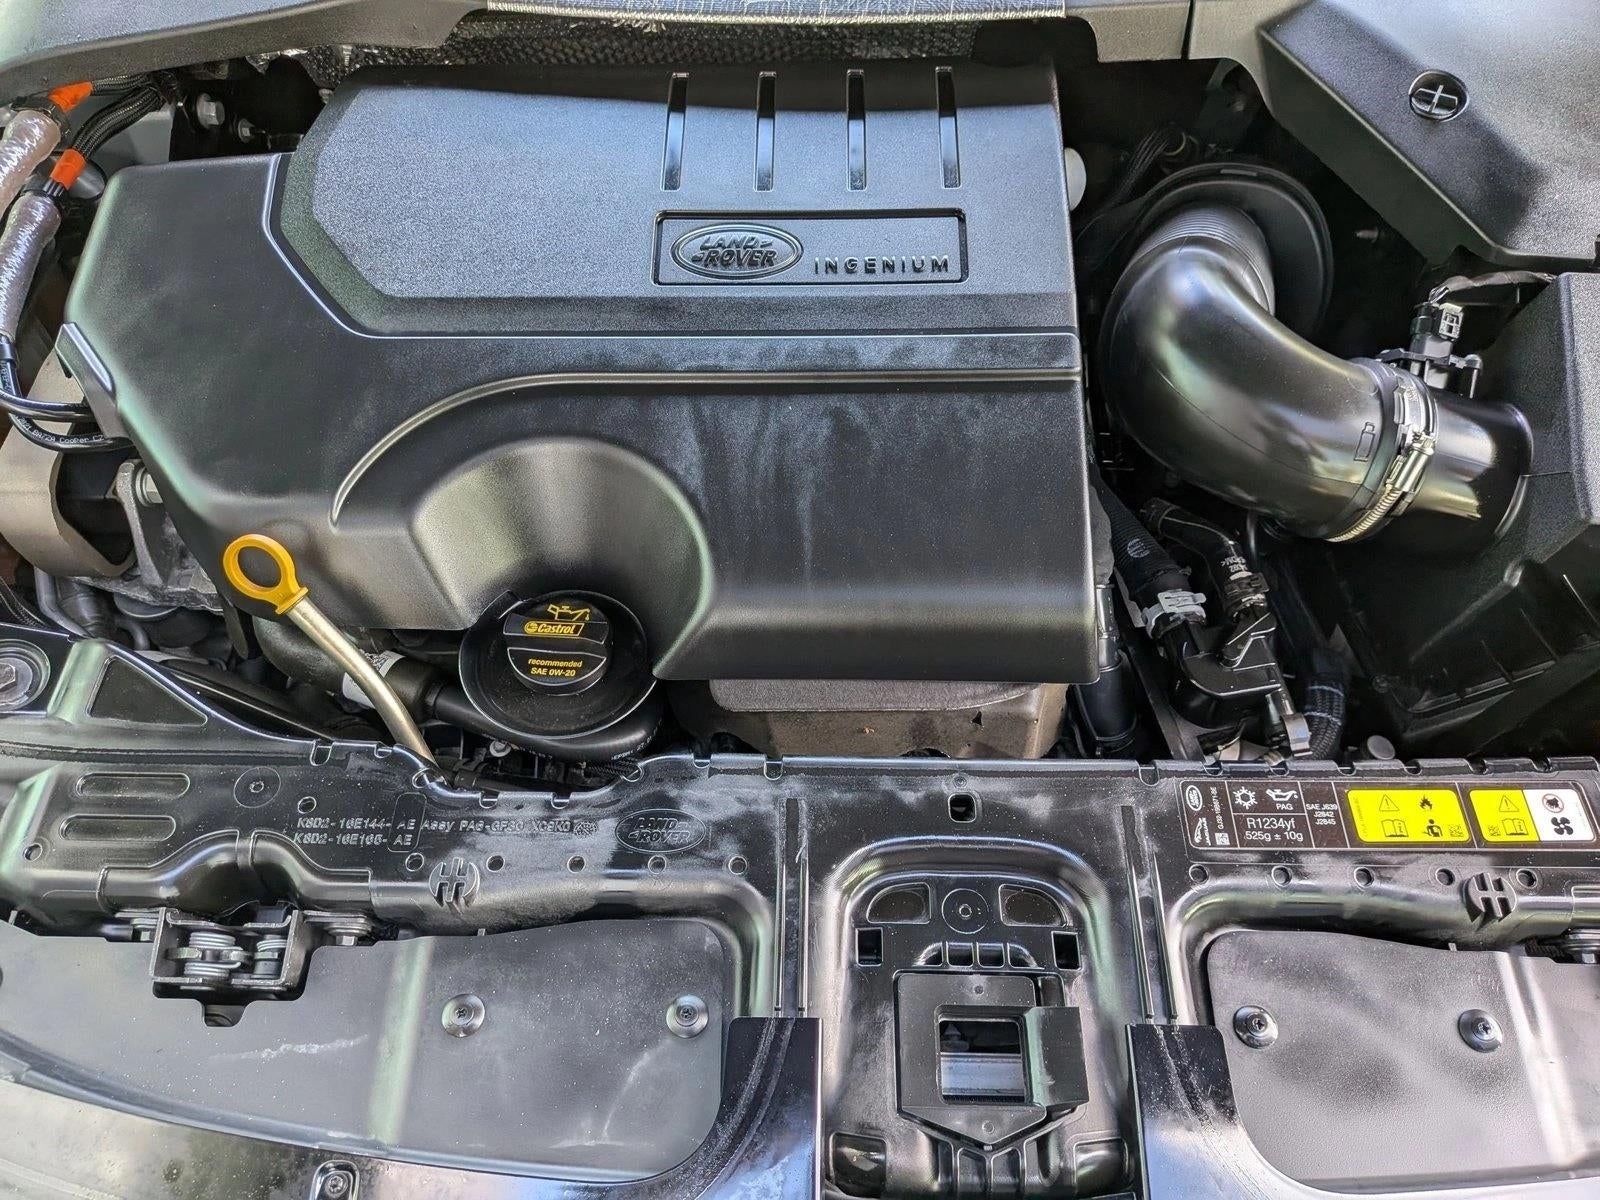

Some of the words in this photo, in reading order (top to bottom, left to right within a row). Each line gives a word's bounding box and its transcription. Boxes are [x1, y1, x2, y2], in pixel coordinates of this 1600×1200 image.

[700, 236, 760, 250] LAND
[703, 249, 777, 267] ROVER
[814, 255, 949, 274] INGENIUM
[537, 623, 576, 634] Castrol
[528, 658, 583, 668] recommended
[531, 667, 547, 676] SAE
[549, 668, 576, 677] 0W-20
[1246, 817, 1295, 831] R1234yf
[636, 829, 690, 843] ROVER
[1245, 831, 1271, 842] 525g
[1284, 831, 1303, 842] 10g
